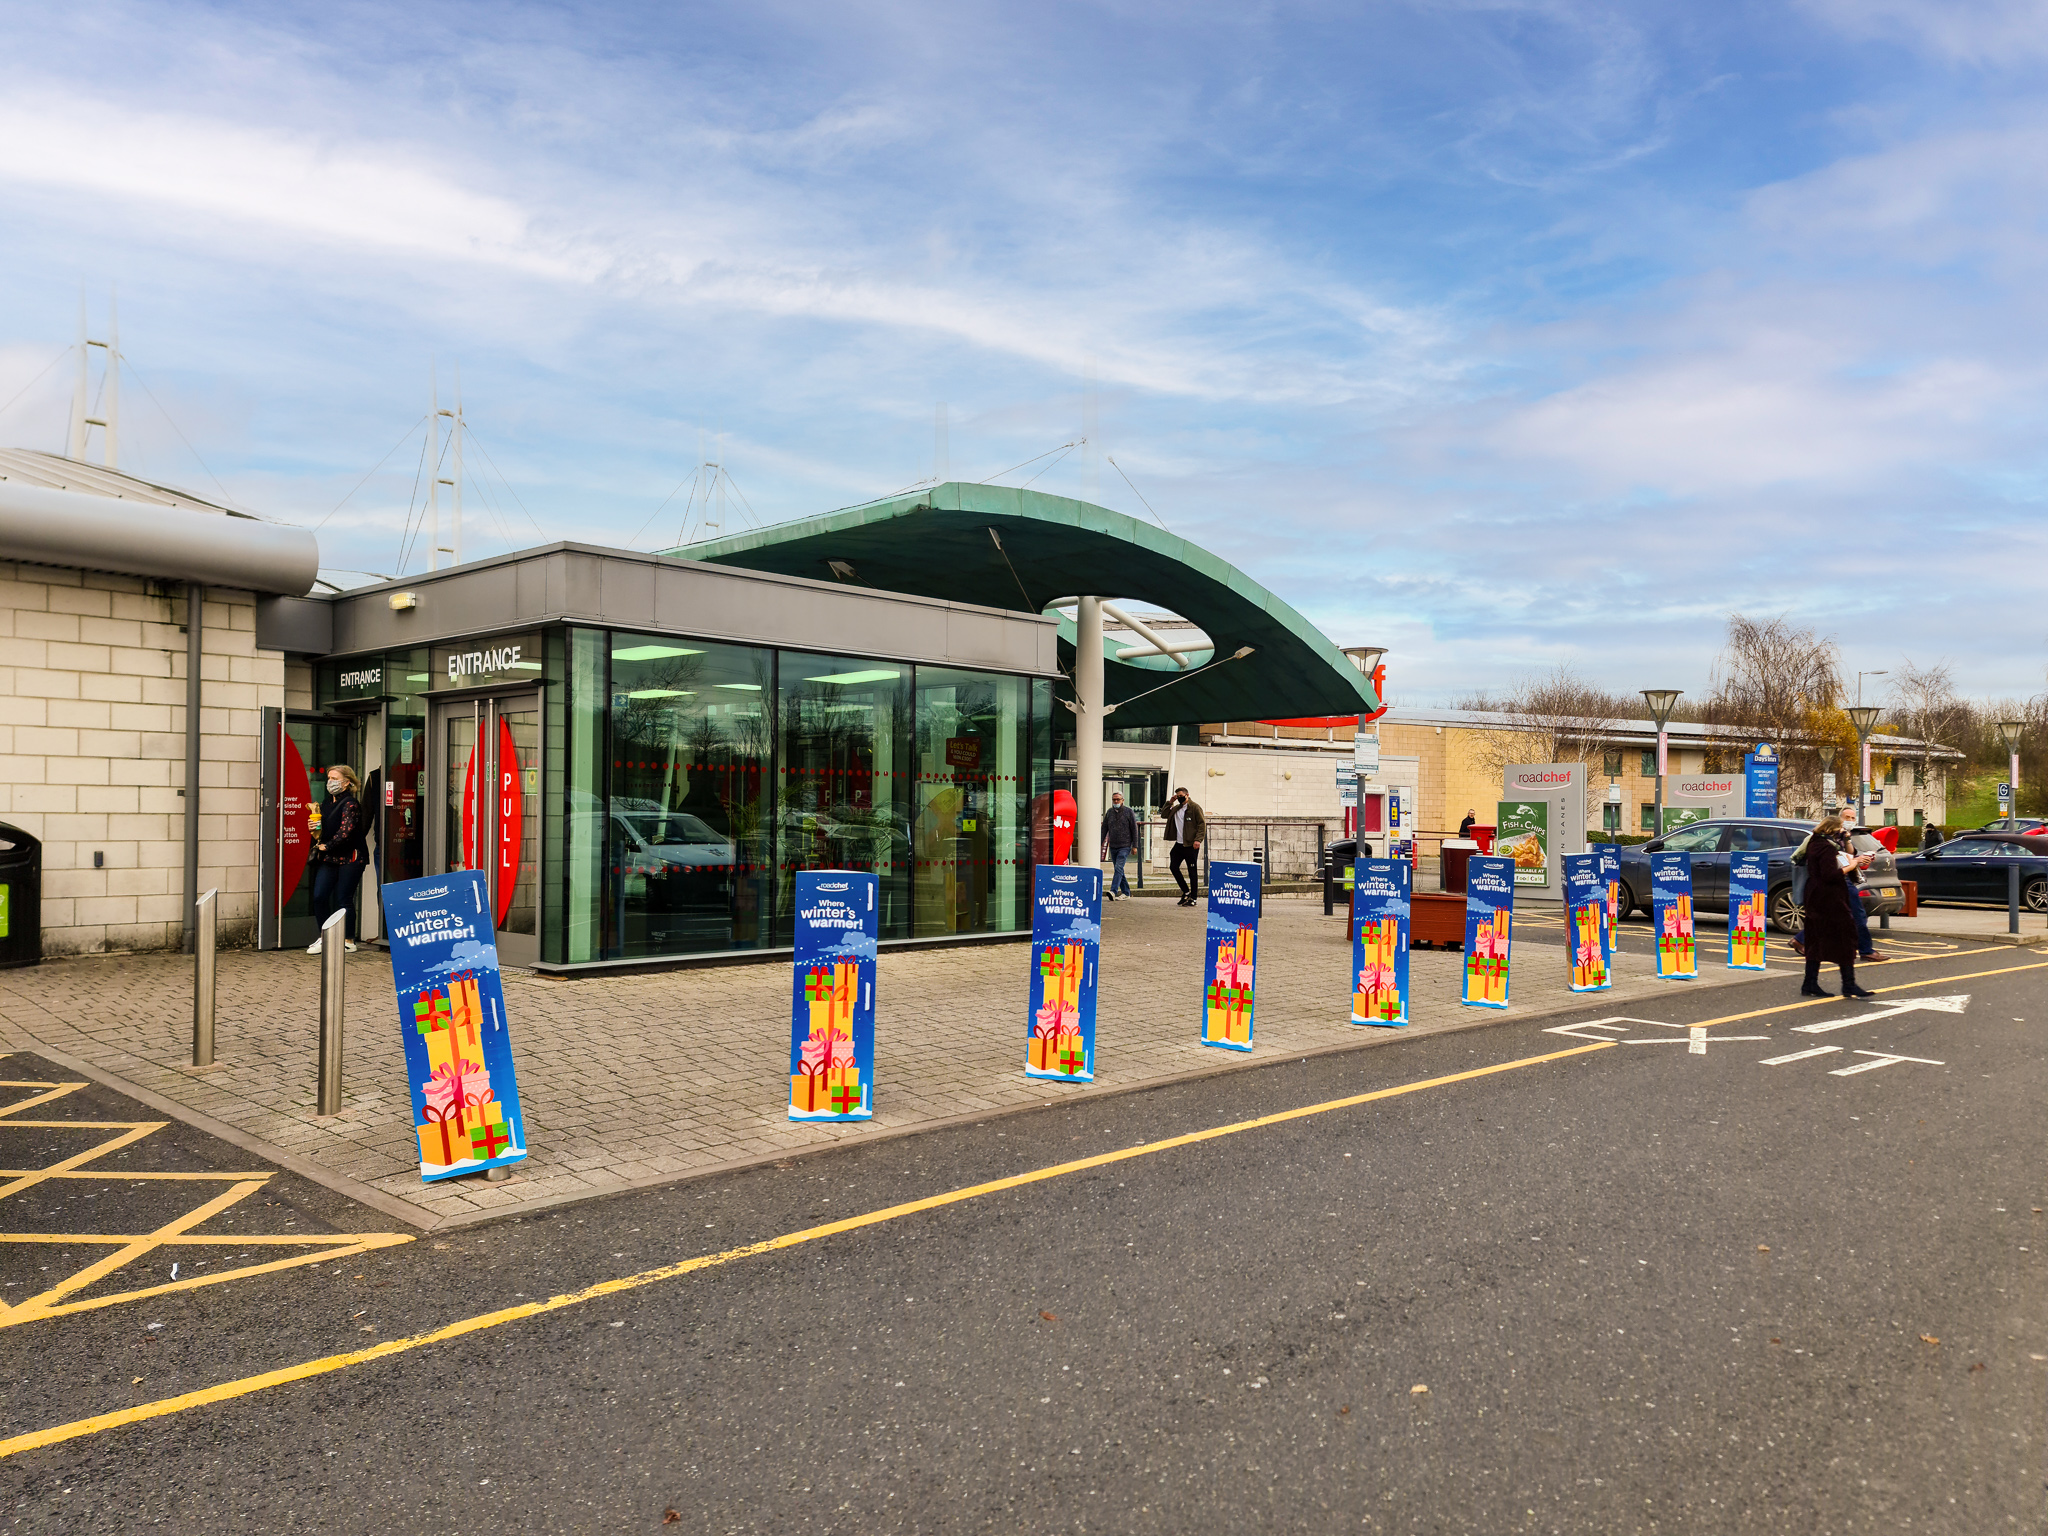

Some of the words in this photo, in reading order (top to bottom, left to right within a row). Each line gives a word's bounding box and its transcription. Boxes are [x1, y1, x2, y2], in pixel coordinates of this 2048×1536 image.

[448, 646, 521, 676] ENTRANCE
[340, 668, 381, 687] ENTRANCE
[950, 741, 964, 750] Let's
[965, 743, 978, 752] Talk
[1519, 771, 1571, 783] roadchef
[1681, 781, 1732, 791] roadchef
[503, 773, 512, 867] PULL
[1502, 821, 1519, 830] FISH
[1524, 821, 1546, 835] CHIPS
[1358, 880, 1396, 890] winter's
[1471, 877, 1506, 886] winter's
[414, 886, 448, 898] roadchef
[1053, 889, 1075, 897] Where
[1212, 887, 1250, 899] winter's
[1364, 889, 1401, 898] warmer!
[1476, 885, 1511, 894] warmer!
[819, 899, 845, 907] Where
[1039, 894, 1083, 907] winter's
[1217, 897, 1256, 908] warmer!
[415, 909, 447, 919] Where
[800, 906, 856, 919] winter's
[1045, 906, 1089, 917] warmer!
[394, 914, 464, 938] winter's
[809, 919, 863, 930] warmer!
[407, 925, 475, 947] warmer!
